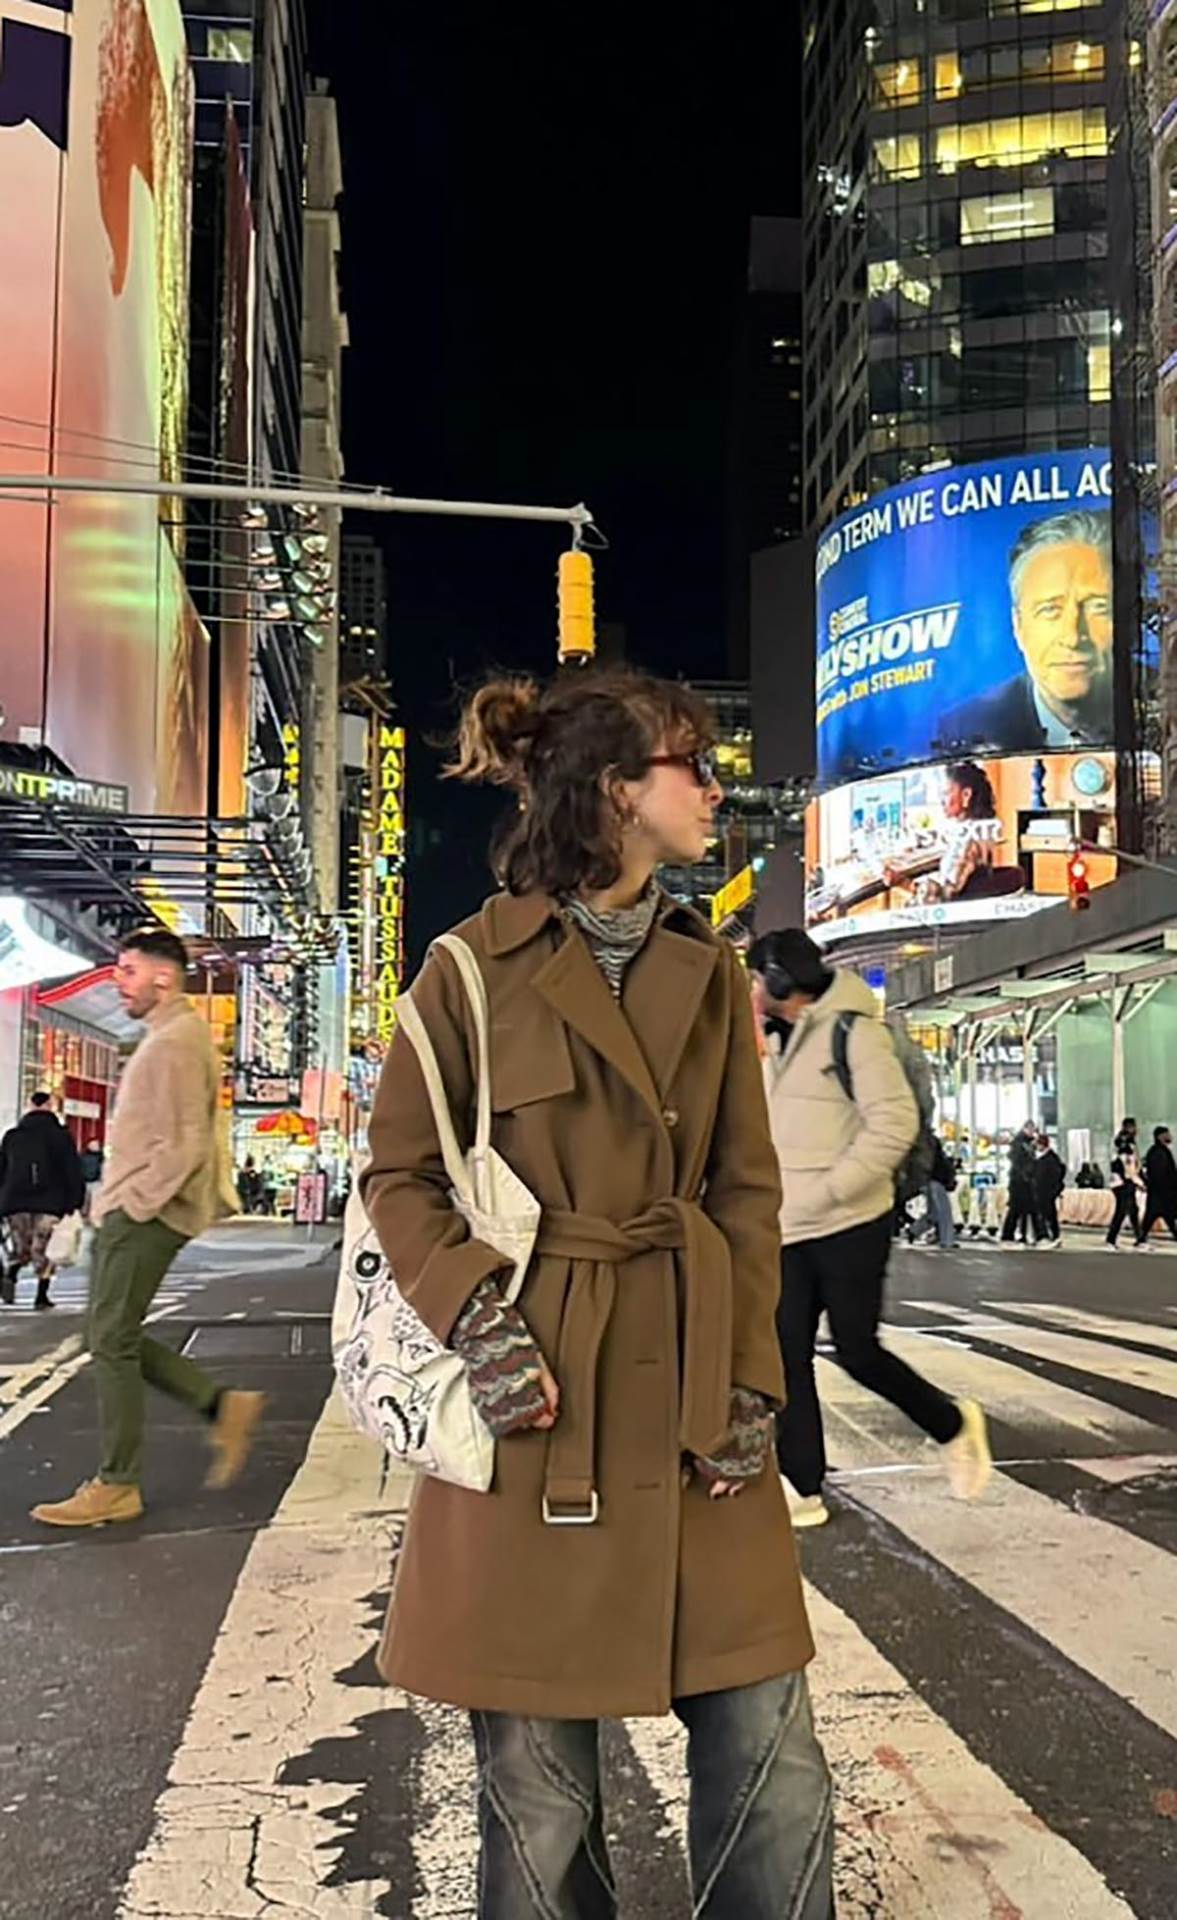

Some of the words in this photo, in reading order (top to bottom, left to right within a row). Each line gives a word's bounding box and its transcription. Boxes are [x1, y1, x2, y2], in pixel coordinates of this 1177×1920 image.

[842, 503, 892, 552] TERM
[896, 488, 935, 530] WE
[941, 473, 1002, 516] CAN
[1010, 466, 1070, 504] ALL
[379, 726, 404, 855] MADAME
